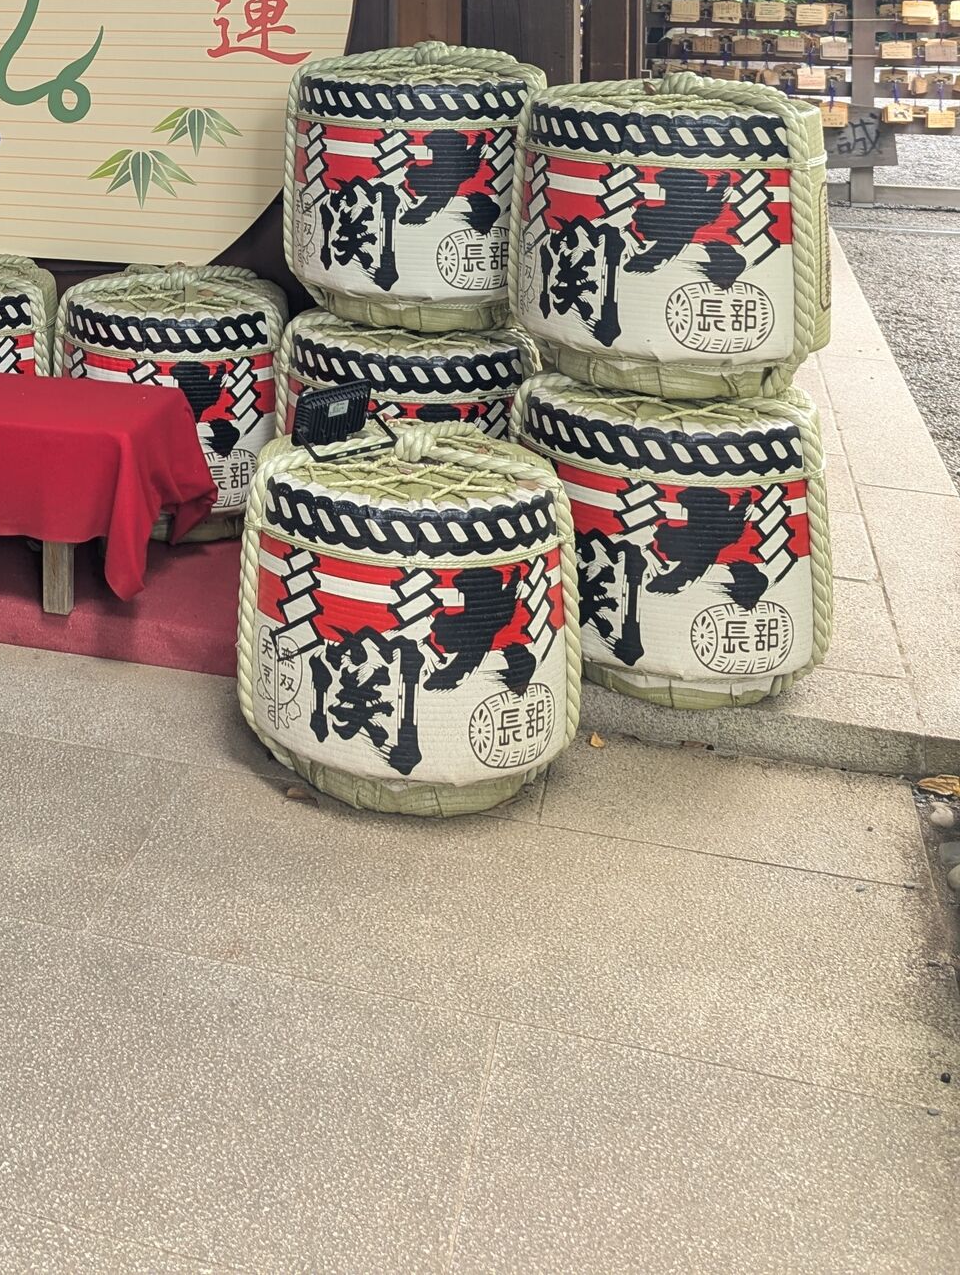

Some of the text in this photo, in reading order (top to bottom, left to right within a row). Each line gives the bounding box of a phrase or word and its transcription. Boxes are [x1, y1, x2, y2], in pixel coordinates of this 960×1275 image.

[827, 112, 883, 156] 誠
[461, 242, 509, 273] 長部
[696, 299, 757, 333] 長部
[721, 618, 779, 653] 長部
[497, 701, 545, 746] 長部
